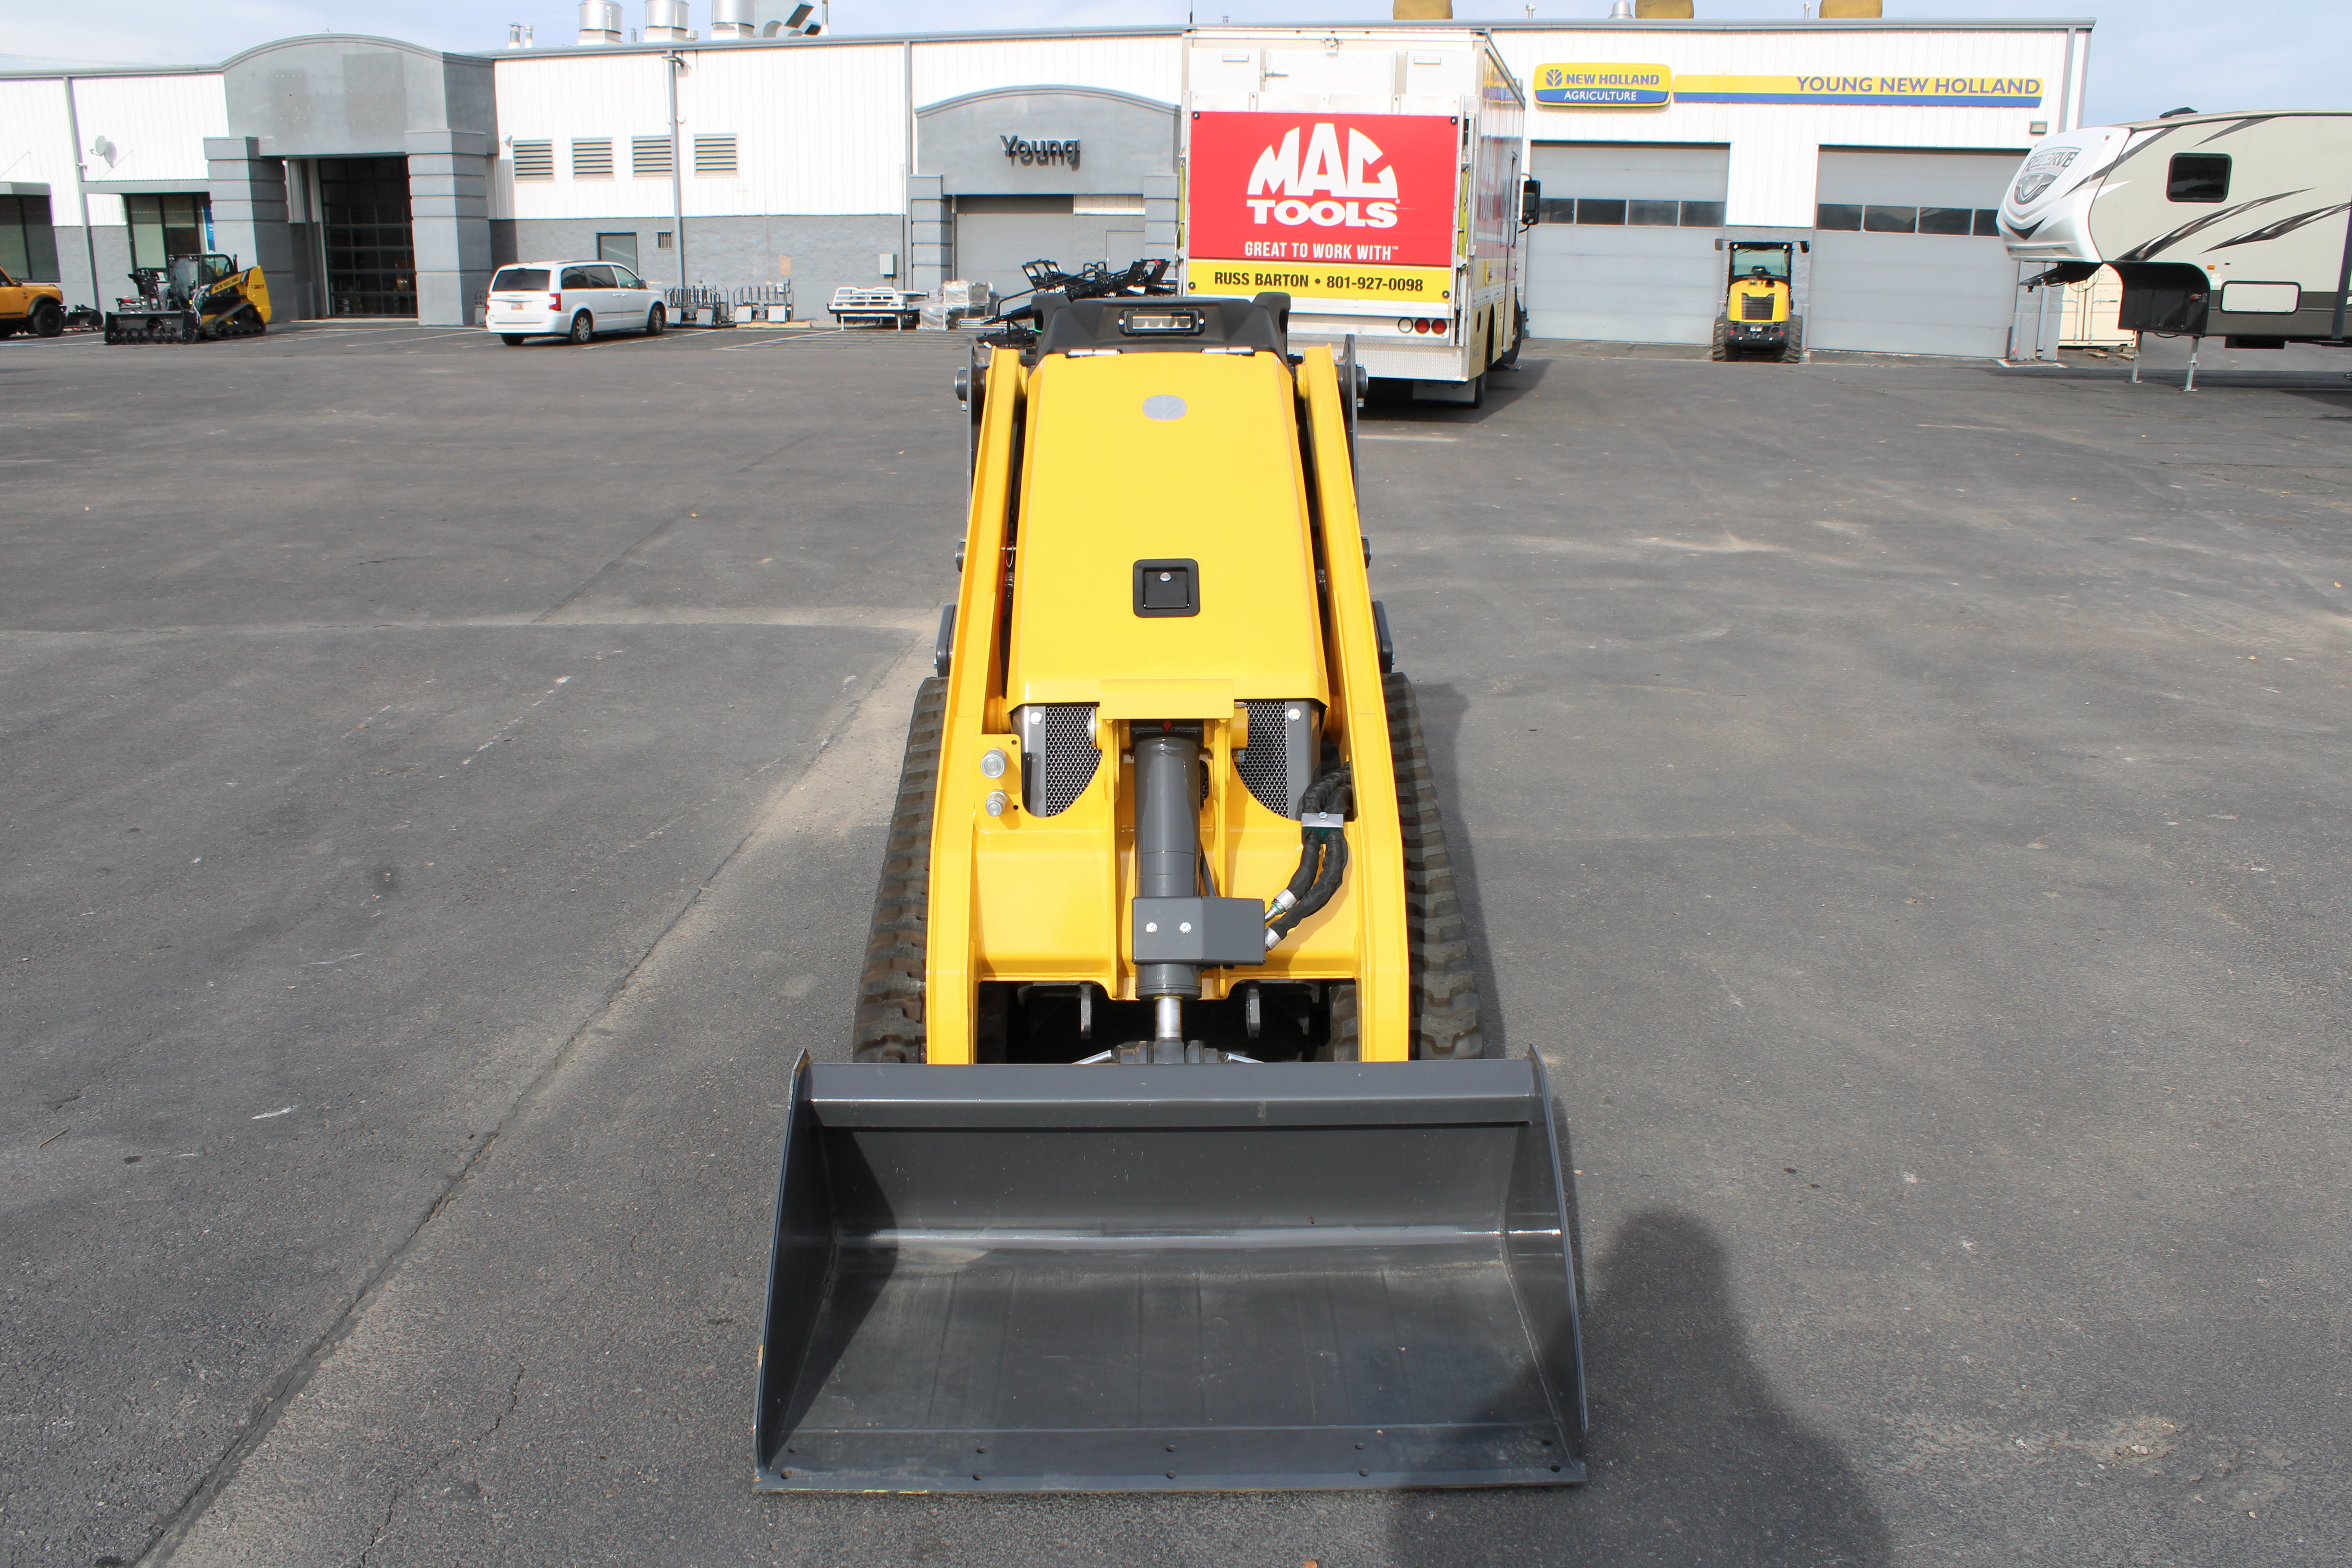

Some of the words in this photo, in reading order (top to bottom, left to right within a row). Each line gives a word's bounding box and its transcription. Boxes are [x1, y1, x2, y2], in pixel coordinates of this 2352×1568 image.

[1566, 74, 1596, 85] NEW
[1599, 74, 1659, 85] HOLLAND
[1796, 76, 1873, 92] YOUNG
[1880, 77, 1929, 93] NEW
[1935, 78, 2040, 94] HOLLAND
[1564, 91, 1637, 101] AGRICULTURE
[1000, 134, 1078, 163] Young
[1247, 122, 1398, 198] MAC
[1246, 199, 1398, 228] TOOLS
[1245, 241, 1287, 257] GREAT
[1291, 242, 1308, 258] TO
[1312, 243, 1353, 259] WORK
[1214, 272, 1250, 285] RUSS
[1254, 273, 1309, 287] BARTON
[1326, 275, 1424, 291] 801-927-0098
